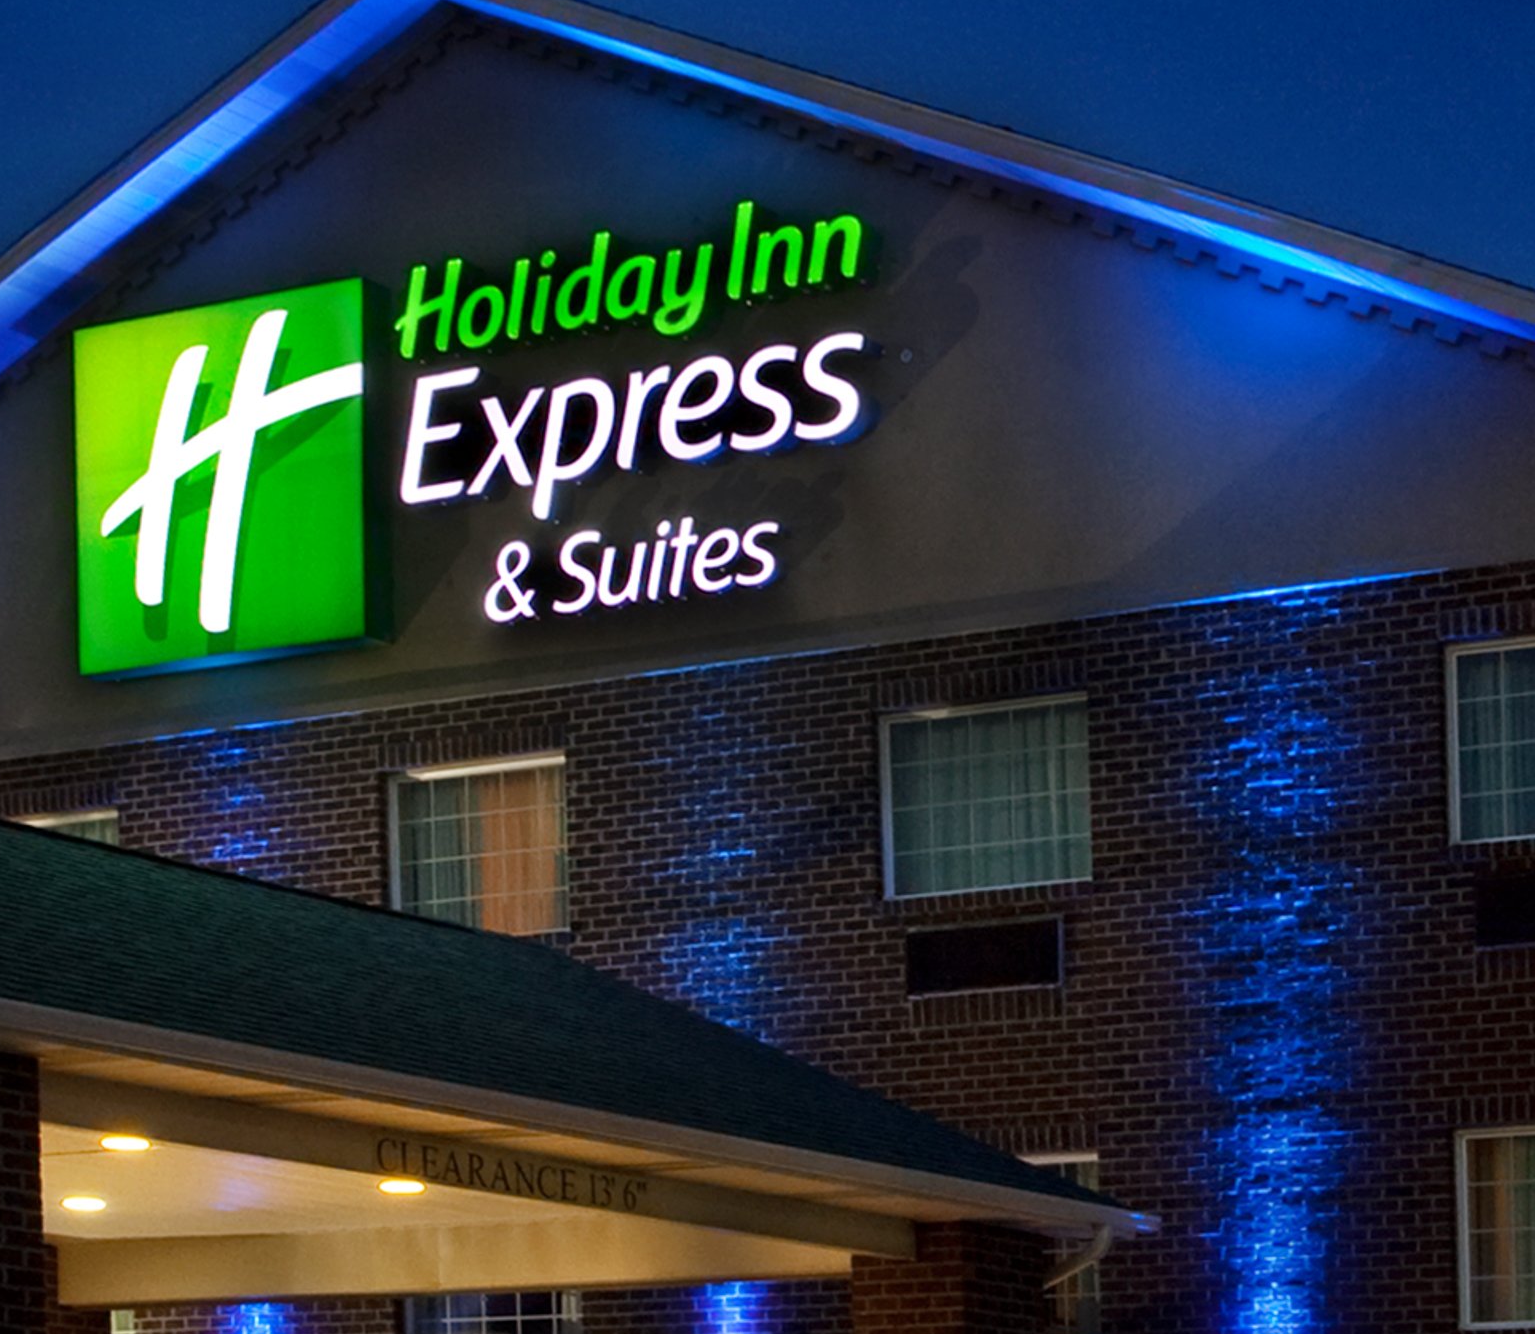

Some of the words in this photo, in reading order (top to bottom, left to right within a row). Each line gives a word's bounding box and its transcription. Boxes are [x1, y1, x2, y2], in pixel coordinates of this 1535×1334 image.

[393, 230, 714, 359] Holiday
[726, 200, 863, 300] Inn
[400, 332, 864, 520] Express
[483, 540, 535, 622] &
[552, 516, 779, 613] Suites
[376, 1138, 578, 1204] CLEARANCE
